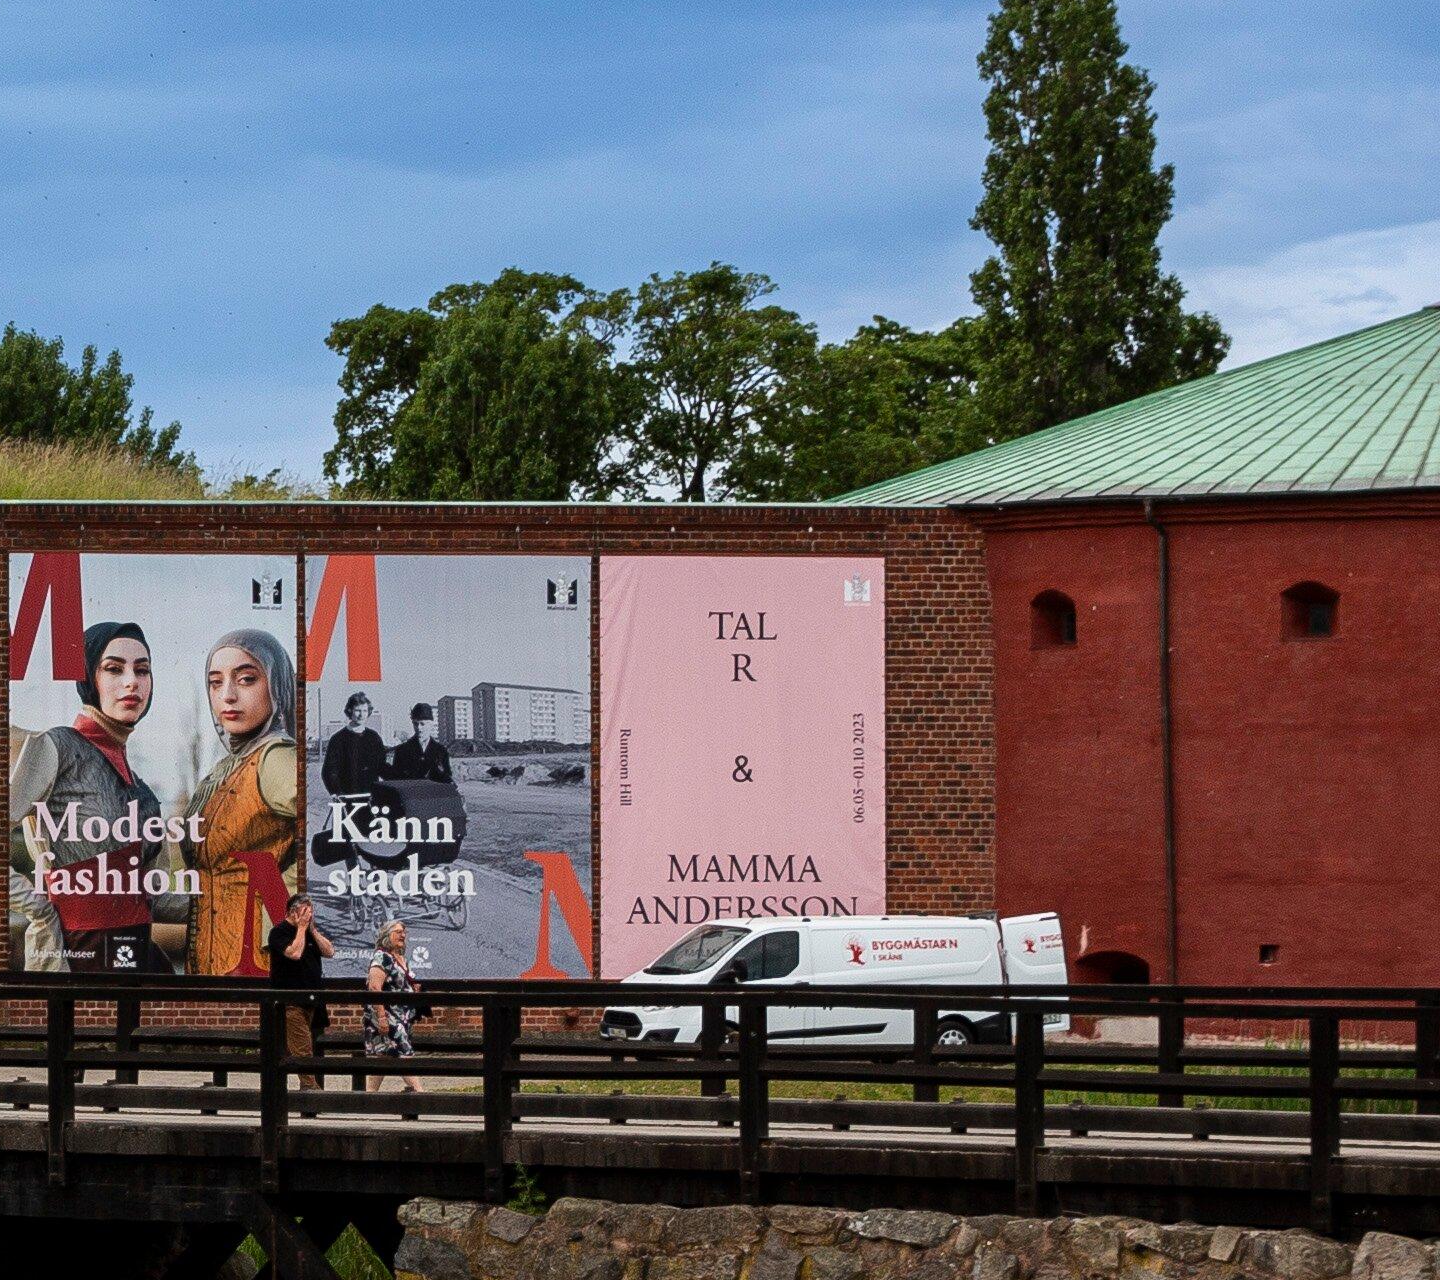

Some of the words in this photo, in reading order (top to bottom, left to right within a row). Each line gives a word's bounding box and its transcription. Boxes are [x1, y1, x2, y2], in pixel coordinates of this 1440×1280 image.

[708, 611, 778, 640] TAL
[731, 653, 757, 682] R
[853, 712, 865, 744] 2023
[732, 755, 753, 783] &
[620, 783, 632, 806] Hill
[32, 799, 207, 843] Modest
[328, 802, 456, 843] Känn
[31, 851, 204, 895] fashion
[327, 852, 477, 896] staden
[667, 854, 822, 883] MAMMA
[626, 895, 858, 924] ANDERSSON
[63, 948, 96, 959] Museer
